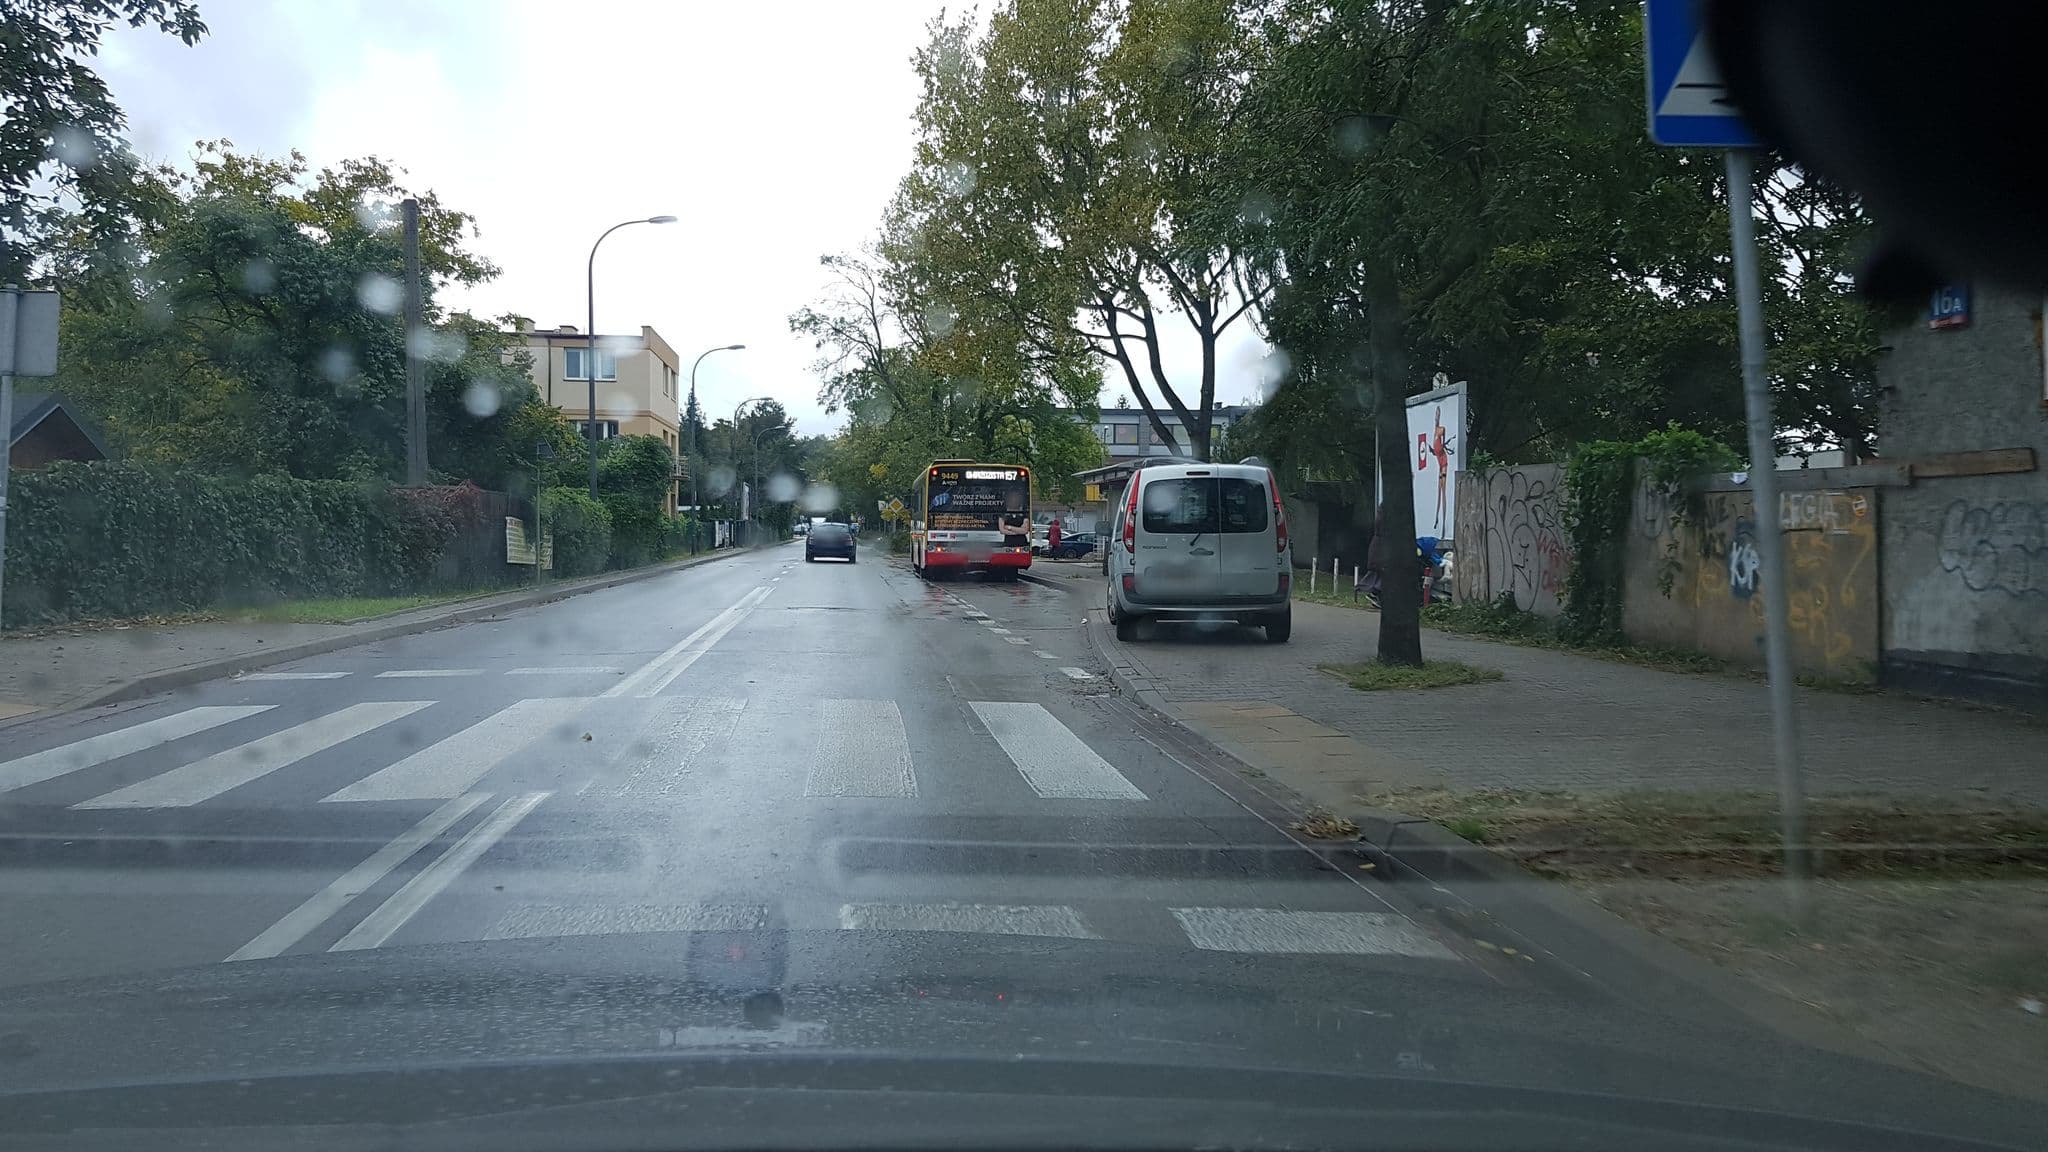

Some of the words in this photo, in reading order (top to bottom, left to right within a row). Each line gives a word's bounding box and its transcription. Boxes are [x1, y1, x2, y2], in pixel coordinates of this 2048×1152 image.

[941, 472, 959, 480] 9449
[1005, 471, 1018, 481] 157
[1779, 492, 1840, 530] LEGIA
